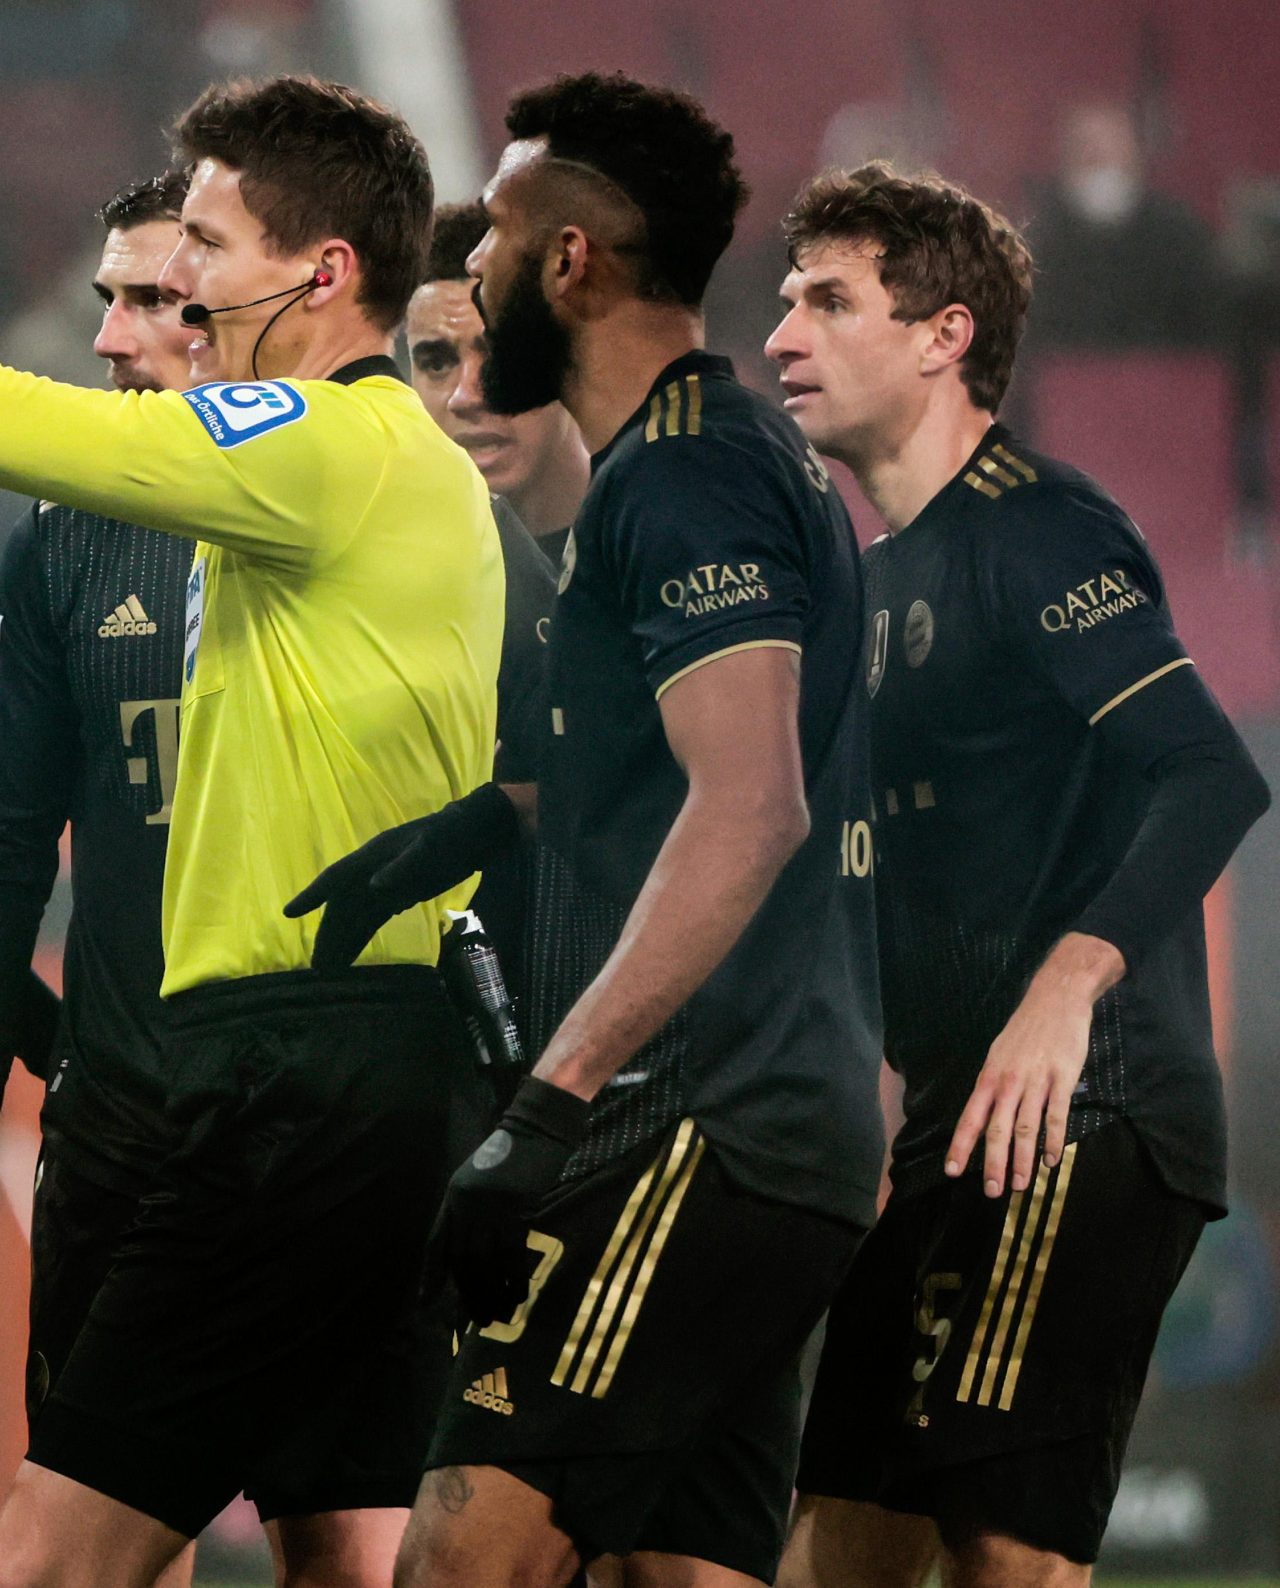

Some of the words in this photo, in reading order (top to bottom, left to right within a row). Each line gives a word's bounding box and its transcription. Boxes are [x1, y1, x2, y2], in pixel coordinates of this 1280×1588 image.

[197, 402, 225, 441] Örtliche
[660, 563, 764, 608] QATAR
[685, 584, 769, 618] AIRWAYS
[1040, 569, 1131, 632] QATAR
[98, 620, 158, 639] adidas
[1077, 589, 1149, 634] AIRWAYS
[463, 1388, 515, 1416] adidas
